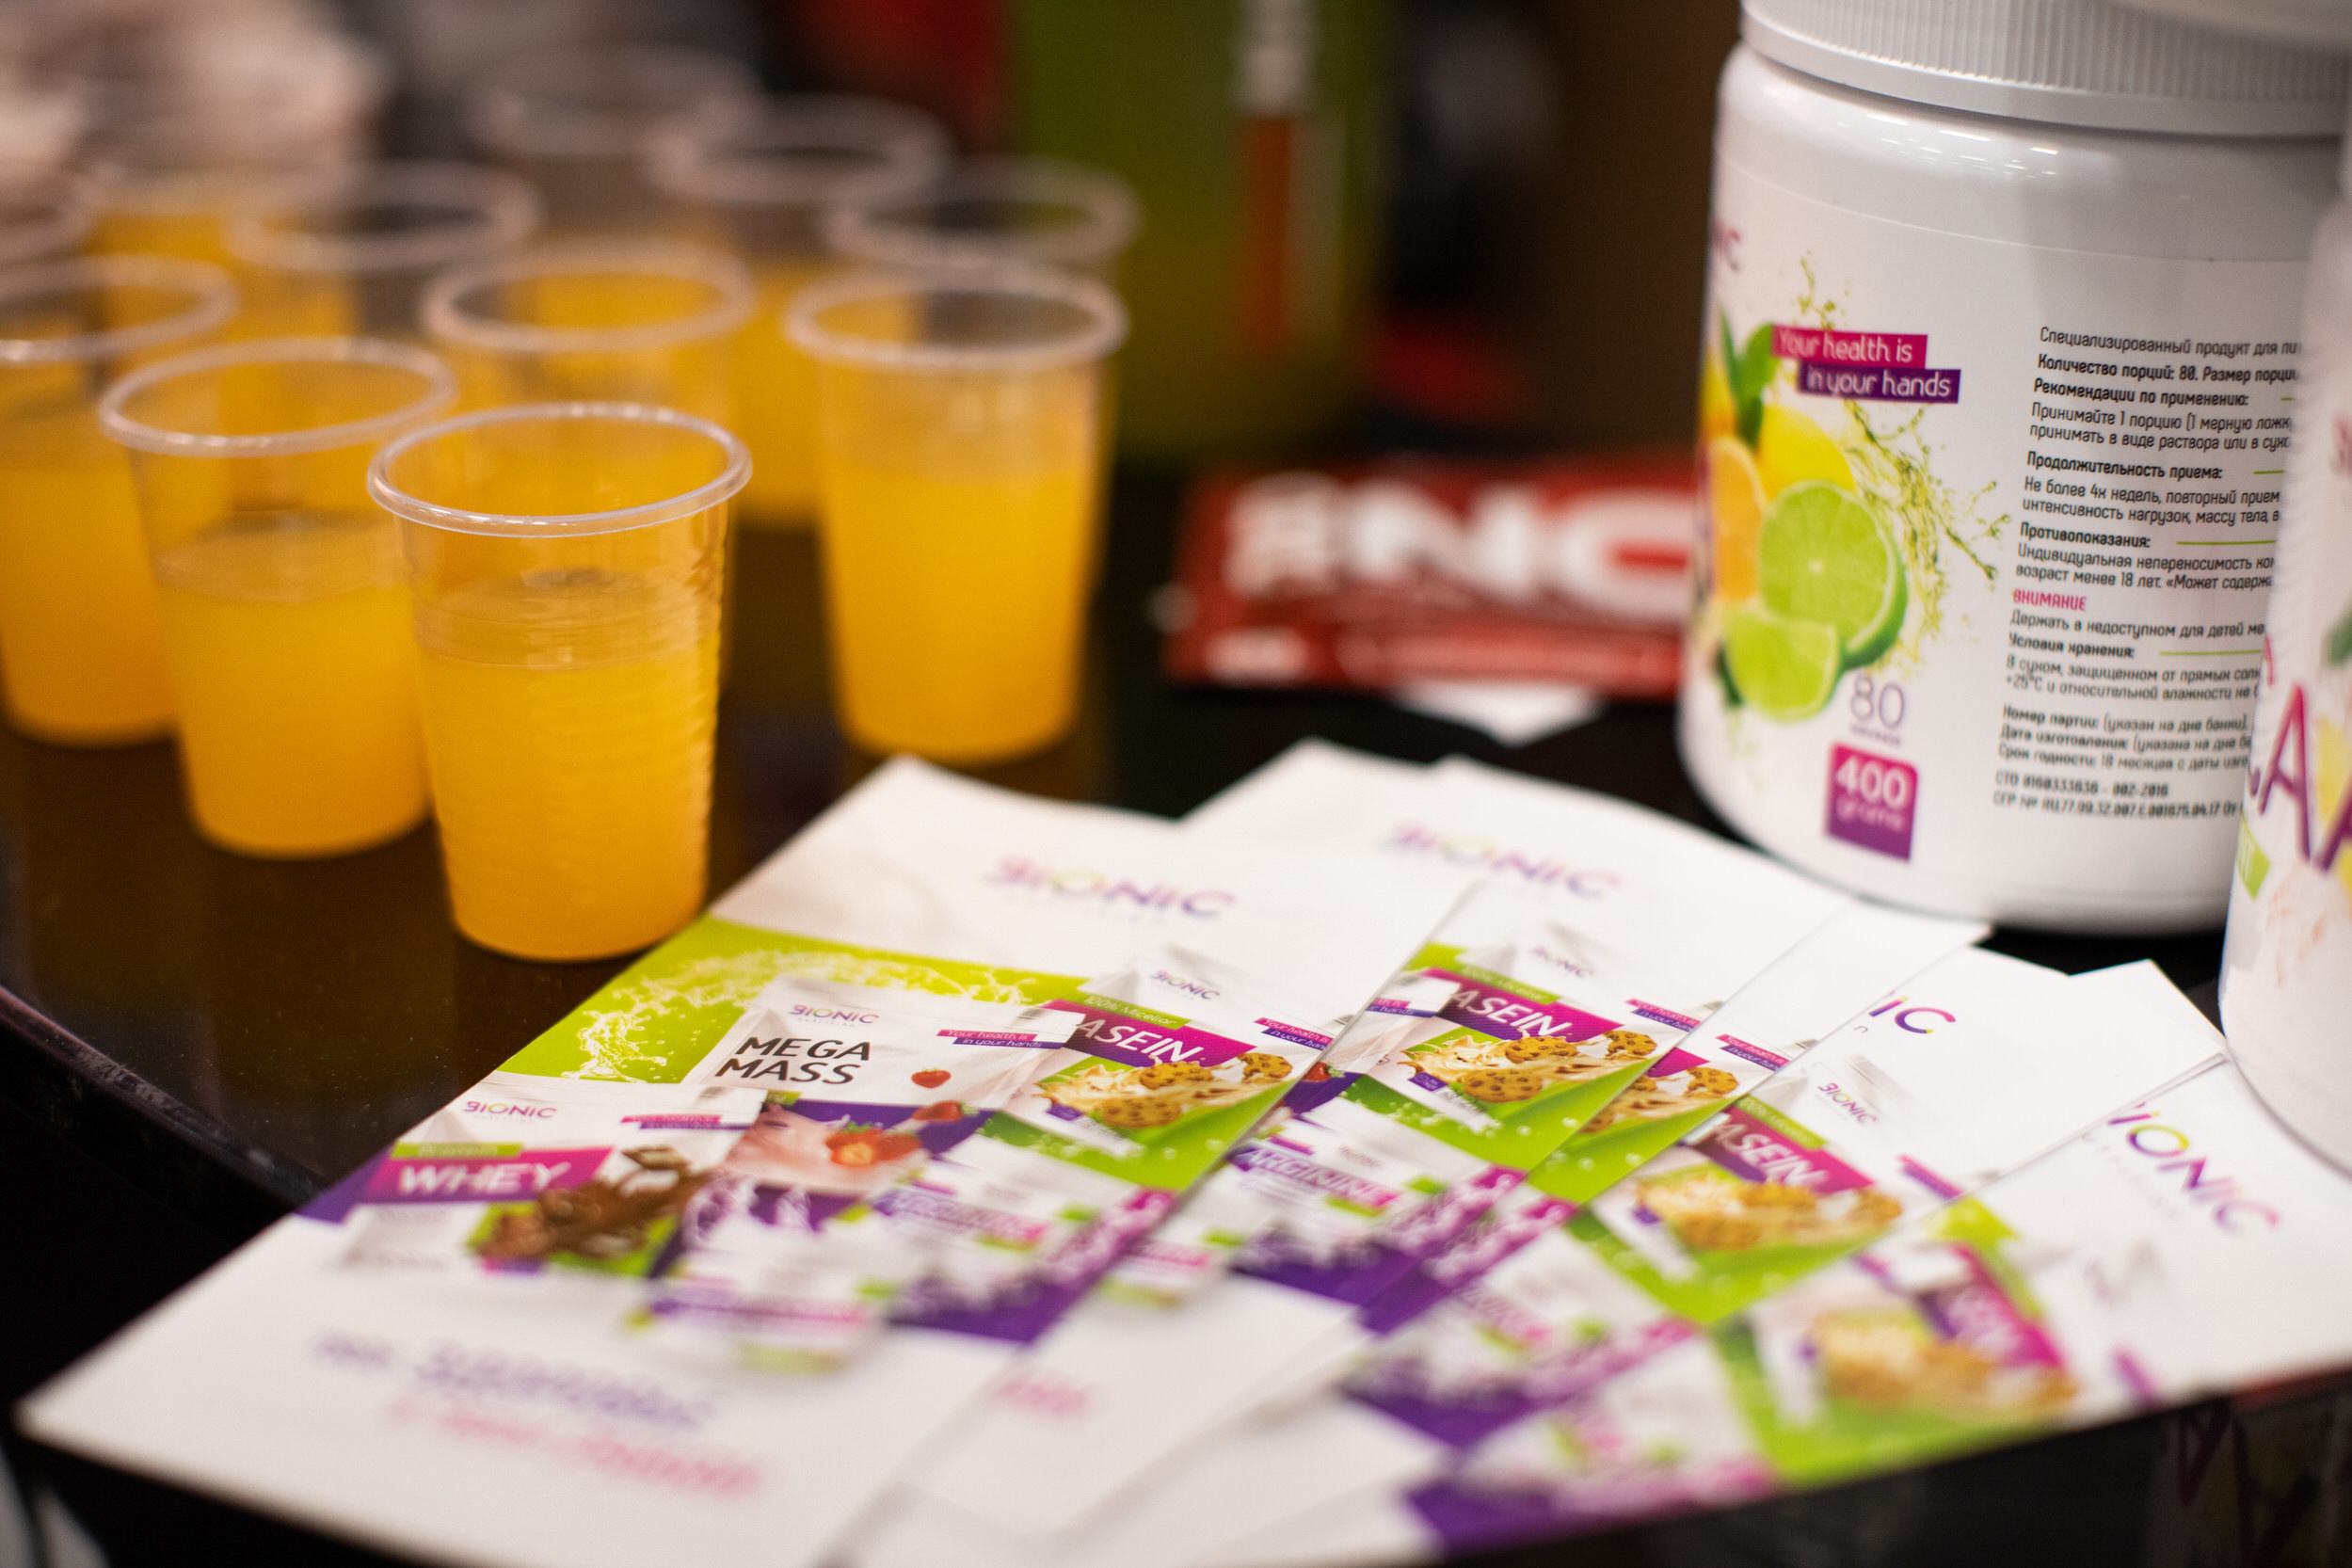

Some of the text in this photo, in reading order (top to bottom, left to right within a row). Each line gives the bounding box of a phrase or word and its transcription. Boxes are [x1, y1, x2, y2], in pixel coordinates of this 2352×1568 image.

[1779, 328, 1913, 363] Your health is
[2040, 326, 2192, 355] Специализированный
[2196, 341, 2251, 359] продукт
[2252, 343, 2279, 357] для
[1806, 365, 1951, 397] in your hands
[2038, 353, 2118, 376] Количество
[2121, 364, 2175, 382] порций:
[2179, 365, 2199, 380] 80.
[2202, 366, 2251, 386] Размер
[2034, 377, 2249, 408] Рекомендации по применению:
[2031, 402, 2116, 425] Принимайте
[2120, 410, 2125, 425] 1
[2129, 415, 2182, 432] порцию
[2200, 418, 2252, 434] мерную
[2029, 424, 2104, 444] принимать
[2109, 433, 2118, 444] в
[2121, 434, 2155, 449] виде
[2158, 436, 2219, 453] раствора
[2223, 437, 2248, 450] или
[2250, 437, 2259, 449] в
[2026, 451, 2223, 482] Продолжительность приема:
[2024, 475, 2041, 492] Не
[2045, 478, 2087, 498] более
[2110, 488, 2162, 504] недель,
[2166, 489, 2236, 507] повторный
[2240, 491, 2280, 507] прием
[2022, 499, 2124, 520] интенсивность
[2128, 508, 2191, 526] нагрузок,
[2195, 511, 2236, 527] массу
[2240, 510, 2269, 523] тела,
[2020, 521, 2152, 549] Противопоказания:
[2017, 542, 2133, 568] Индивидуальная
[2136, 557, 2252, 573] непереносимость
[2015, 565, 2070, 583] возраст
[2073, 571, 2117, 585] менее
[2120, 571, 2134, 587] 18
[2136, 576, 2162, 589] лет.
[2166, 574, 2219, 589] «Может
[2009, 609, 2070, 630] Держать
[2073, 620, 2082, 632] в
[2087, 621, 2176, 640] недоступном
[2179, 625, 2204, 639] для
[2207, 621, 2245, 639] детей
[2008, 632, 2135, 659] Условия хранения:
[2006, 653, 2015, 669] В
[2019, 659, 2063, 678] сухом,
[2067, 664, 2158, 682] защищенном
[2161, 670, 2176, 681] от
[2180, 669, 2232, 686] прямых
[1849, 671, 1906, 729] 80
[2046, 681, 2056, 694] и
[2058, 682, 2158, 700] относительной
[2161, 688, 2232, 701] влажности
[2234, 685, 2250, 699] не
[2002, 703, 2046, 726] Номер
[2158, 719, 2175, 731] на
[2177, 719, 2202, 734] дне
[1999, 722, 2033, 743] Дата
[2194, 738, 2210, 750] на
[2212, 736, 2236, 752] дне
[1997, 742, 2031, 760] Срок
[2101, 752, 2114, 767] 18
[2117, 756, 2174, 771] месяцев
[2187, 757, 2220, 772] даты
[1836, 756, 1909, 810] 400
[735, 1036, 871, 1061] MEGA
[947, 1029, 976, 1037] Your
[978, 1031, 1016, 1039] health
[1006, 1039, 1043, 1048] hands
[1077, 1018, 1205, 1063] ASEIN
[714, 1057, 861, 1084] MASS
[399, 1161, 572, 1195] WHEY
[2106, 1110, 2282, 1234] IONIC
